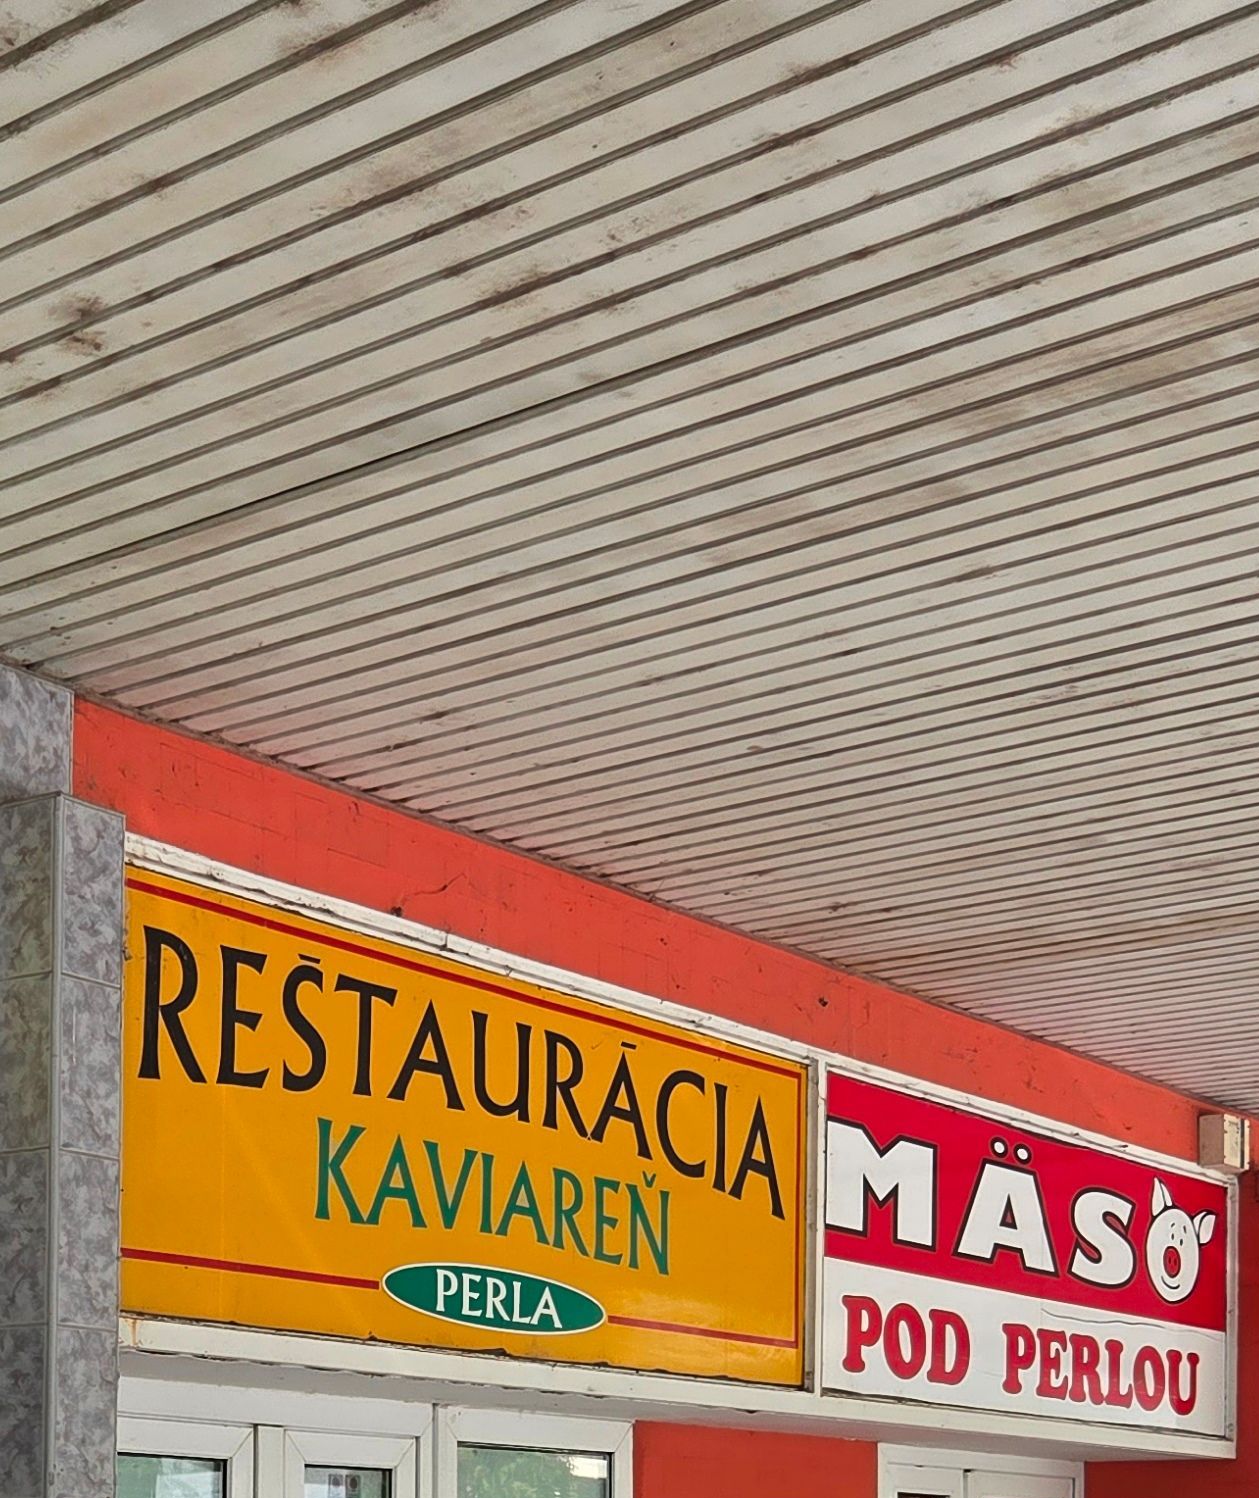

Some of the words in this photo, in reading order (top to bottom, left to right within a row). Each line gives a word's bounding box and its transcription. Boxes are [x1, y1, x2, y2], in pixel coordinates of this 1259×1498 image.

[314, 1116, 671, 1276] KAVIAREŇ
[435, 1268, 563, 1330] PERLA
[841, 1294, 971, 1386] POD
[1001, 1322, 1200, 1417] PERLOU
